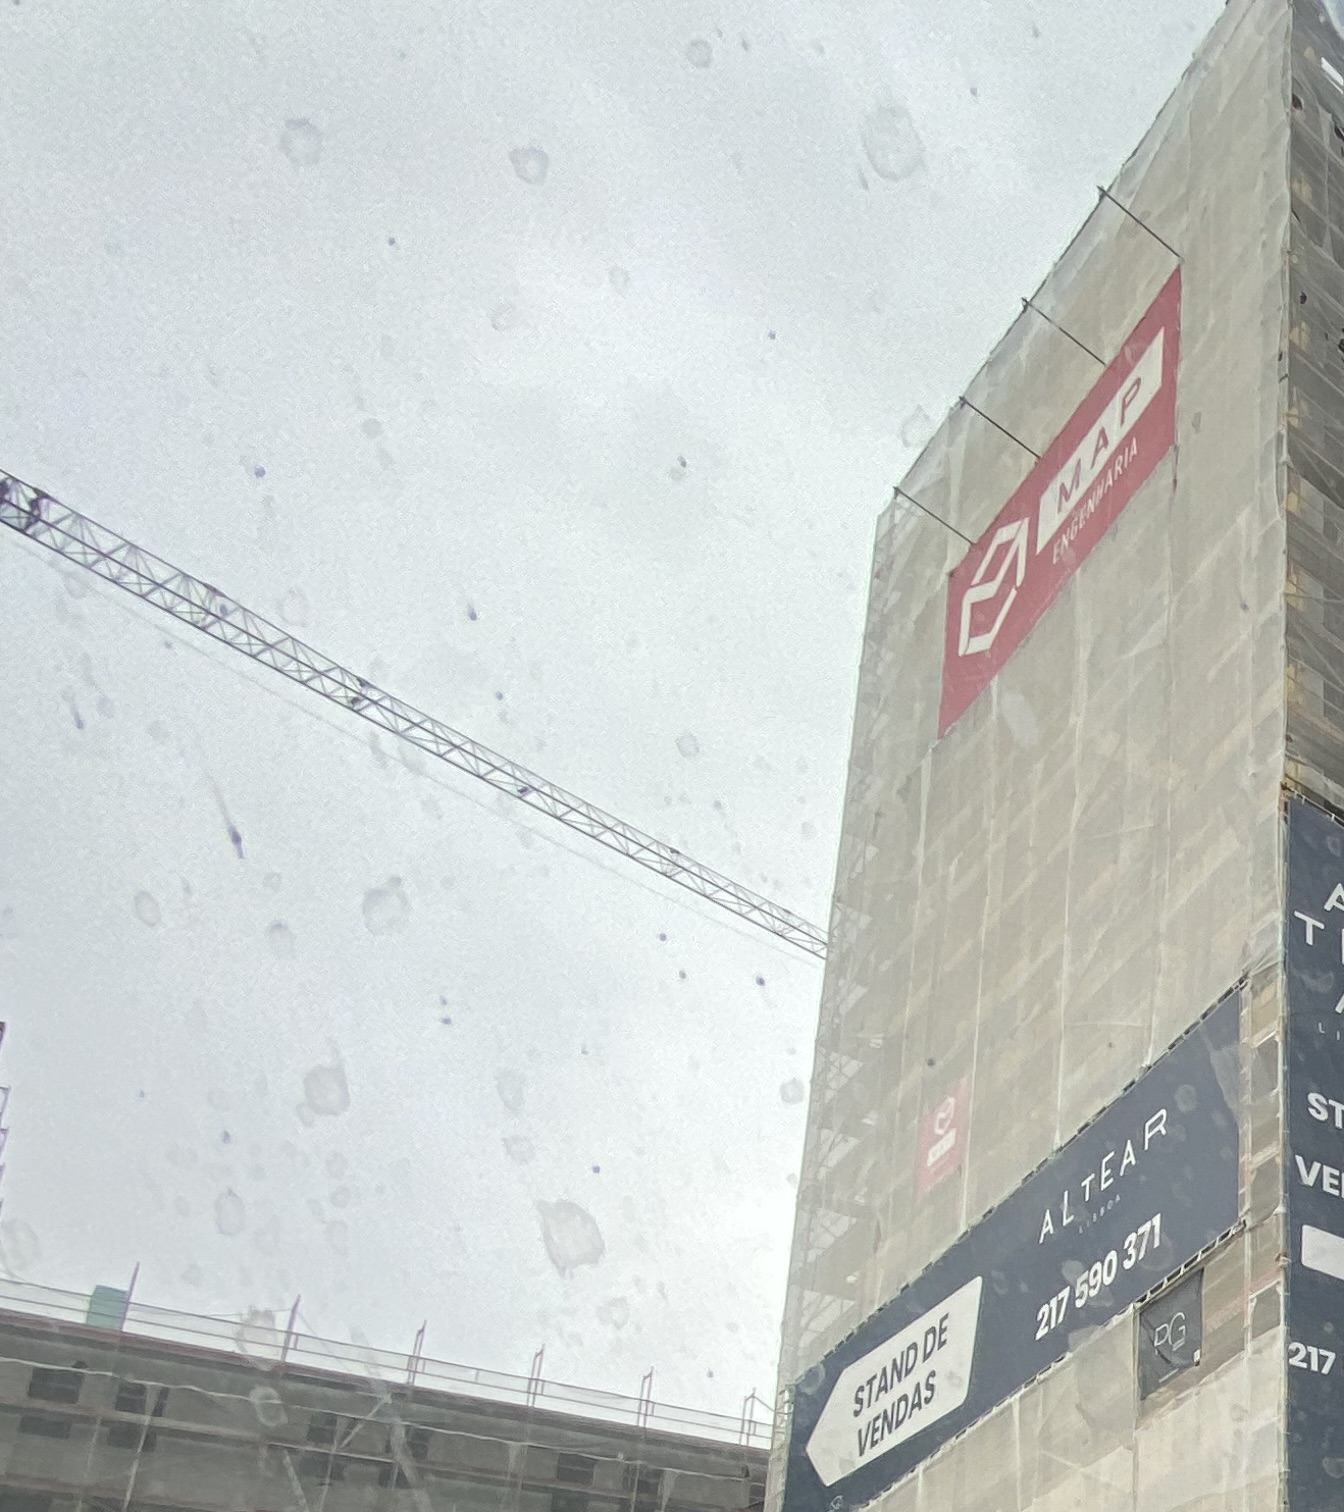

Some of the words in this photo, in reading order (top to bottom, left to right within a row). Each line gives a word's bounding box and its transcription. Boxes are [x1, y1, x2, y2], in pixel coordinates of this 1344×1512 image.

[1057, 376, 1141, 514] MAP
[1038, 1108, 1168, 1245] ALTEAR
[1034, 1286, 1071, 1342] 217
[1075, 1250, 1119, 1309] 590
[1122, 1213, 1162, 1271] 371
[853, 1341, 919, 1418] STAND
[922, 1312, 949, 1364] DE
[857, 1369, 937, 1458] VENDAS
[1287, 1341, 1336, 1375] 217
